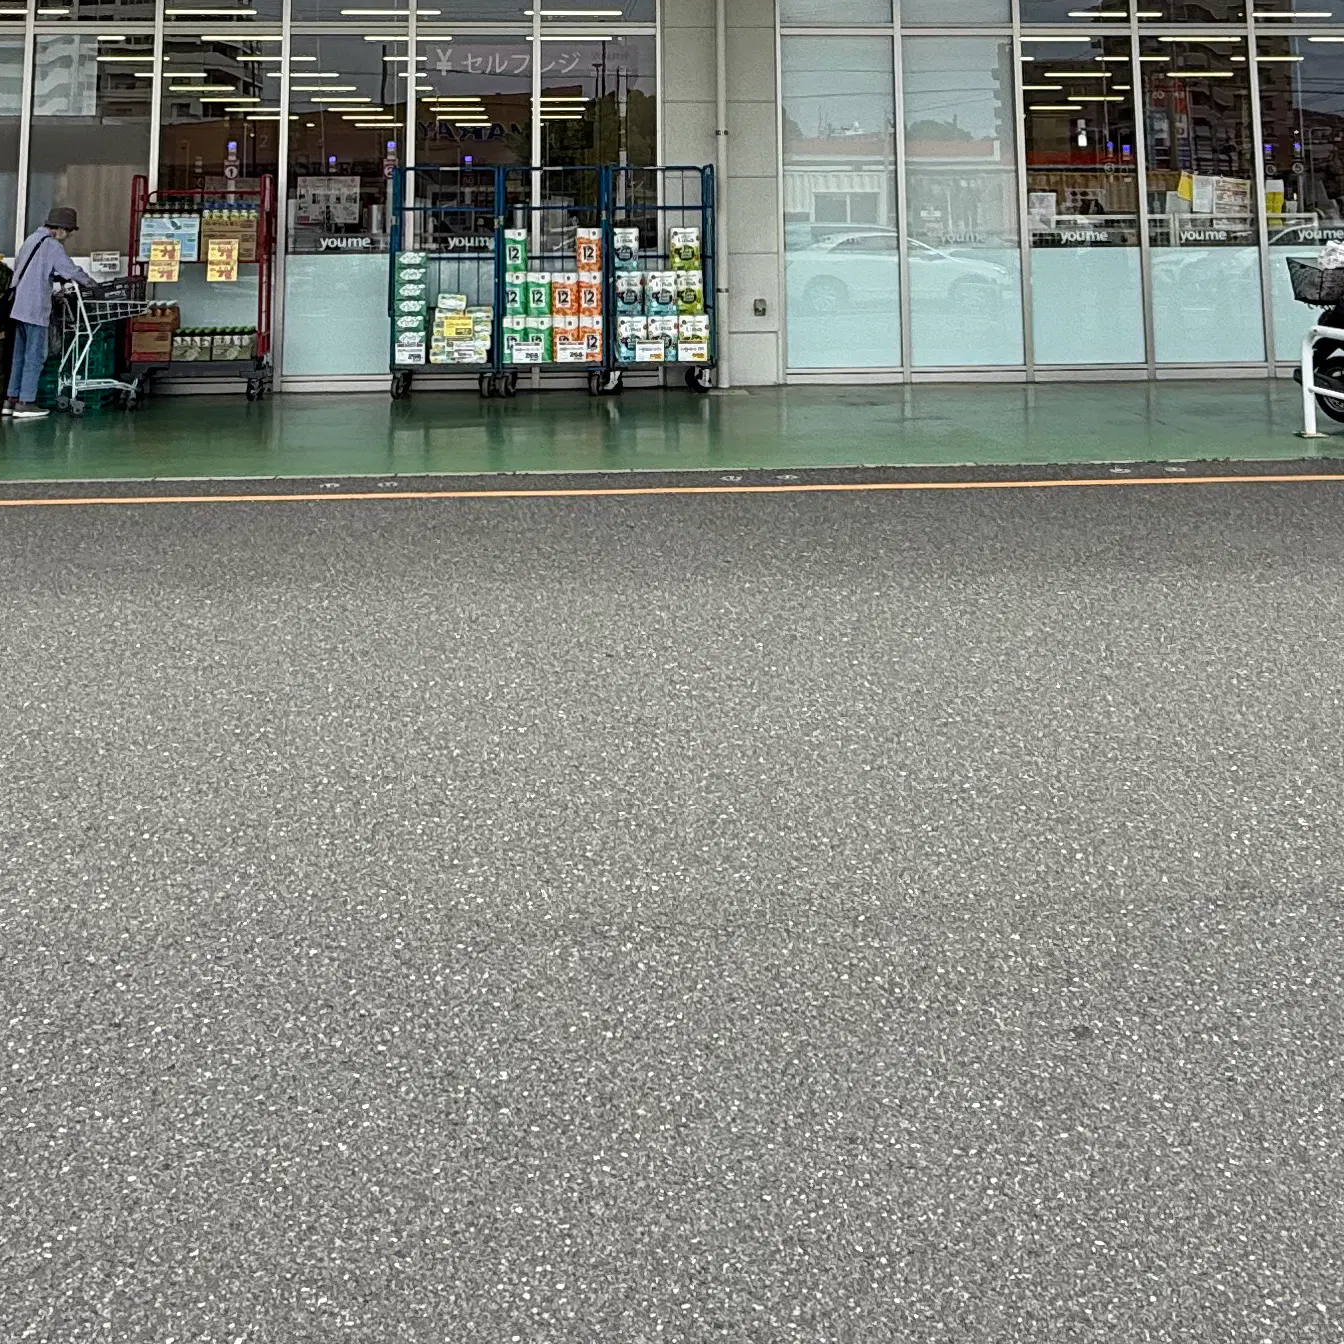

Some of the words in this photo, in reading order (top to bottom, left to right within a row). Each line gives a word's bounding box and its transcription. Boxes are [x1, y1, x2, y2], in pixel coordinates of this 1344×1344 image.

[1060, 230, 1109, 244] youme
[1179, 230, 1228, 243] youme
[319, 237, 371, 251] youme
